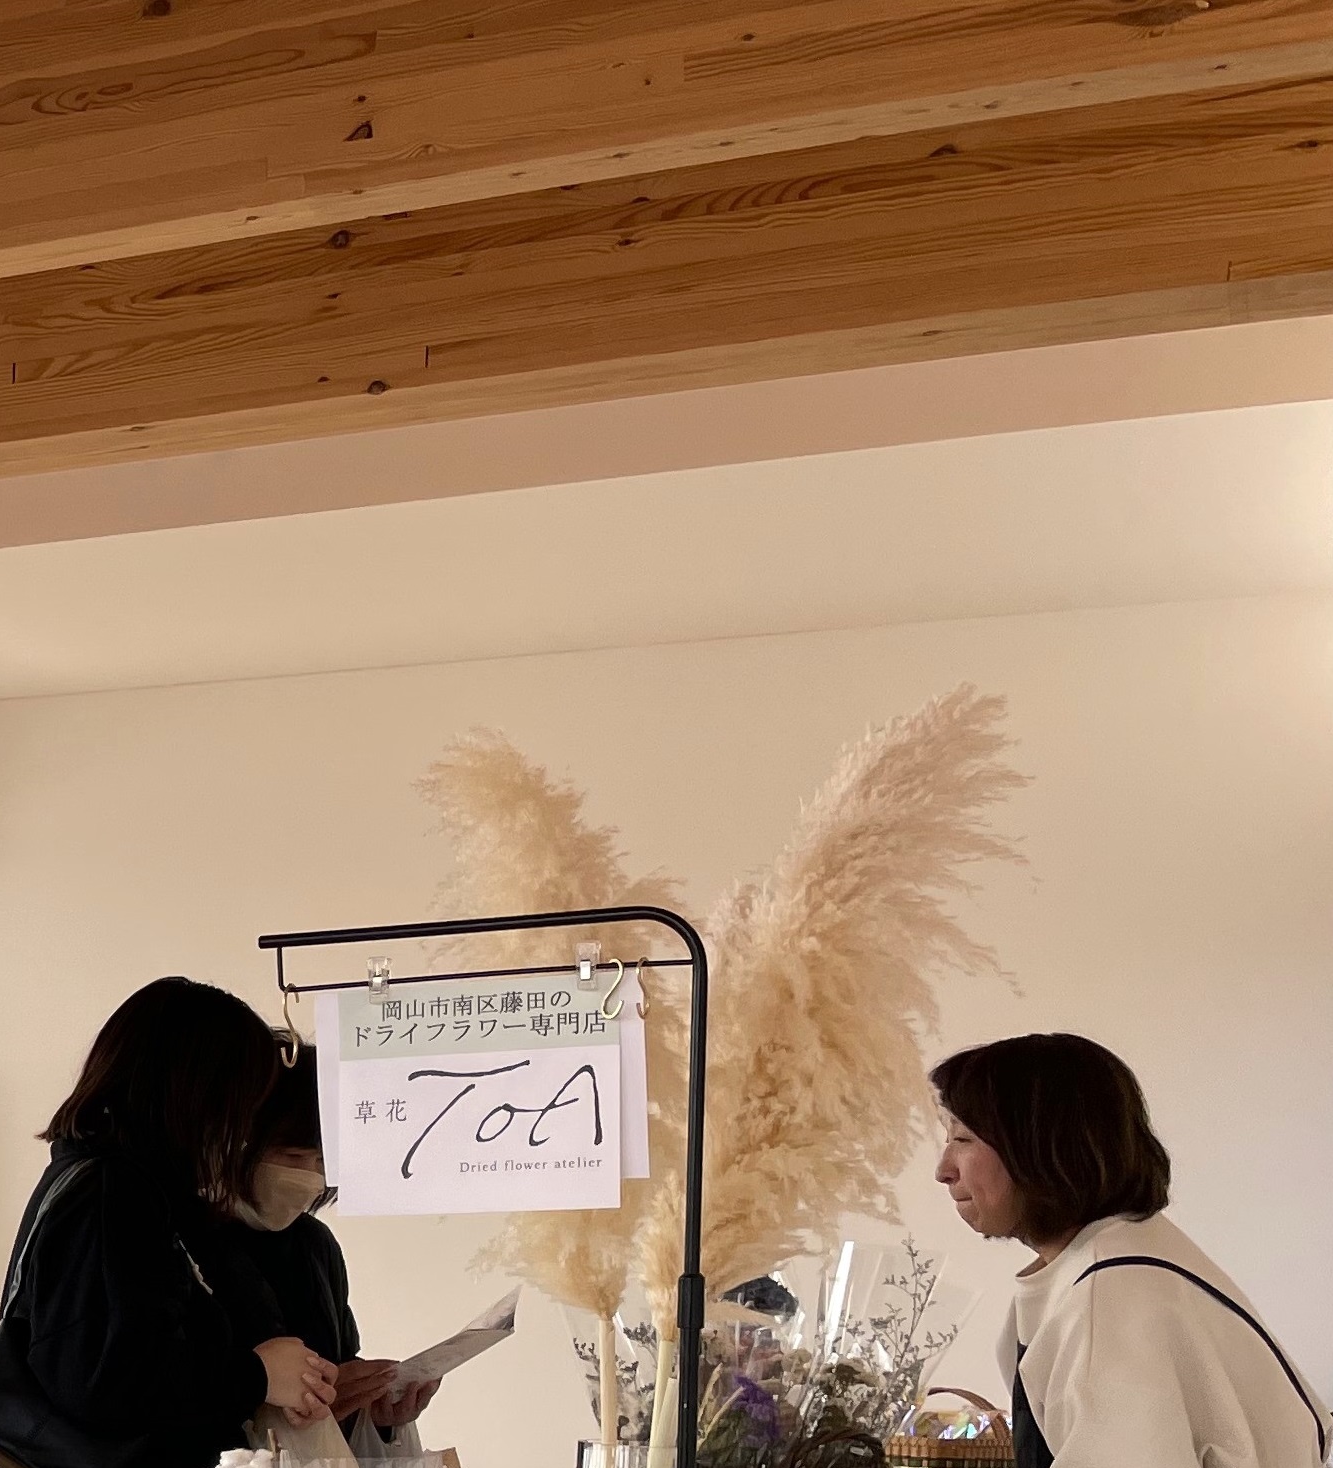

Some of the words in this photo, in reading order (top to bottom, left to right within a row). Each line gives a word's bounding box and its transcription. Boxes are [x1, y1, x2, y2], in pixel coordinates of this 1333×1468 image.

[381, 990, 572, 1022] 岡山市南区藤田の
[354, 1009, 607, 1048] ドライフラワー専門店
[354, 1099, 408, 1125] 草花
[459, 1160, 498, 1174] Dried
[504, 1158, 548, 1172] flower
[554, 1156, 603, 1170] atelier
